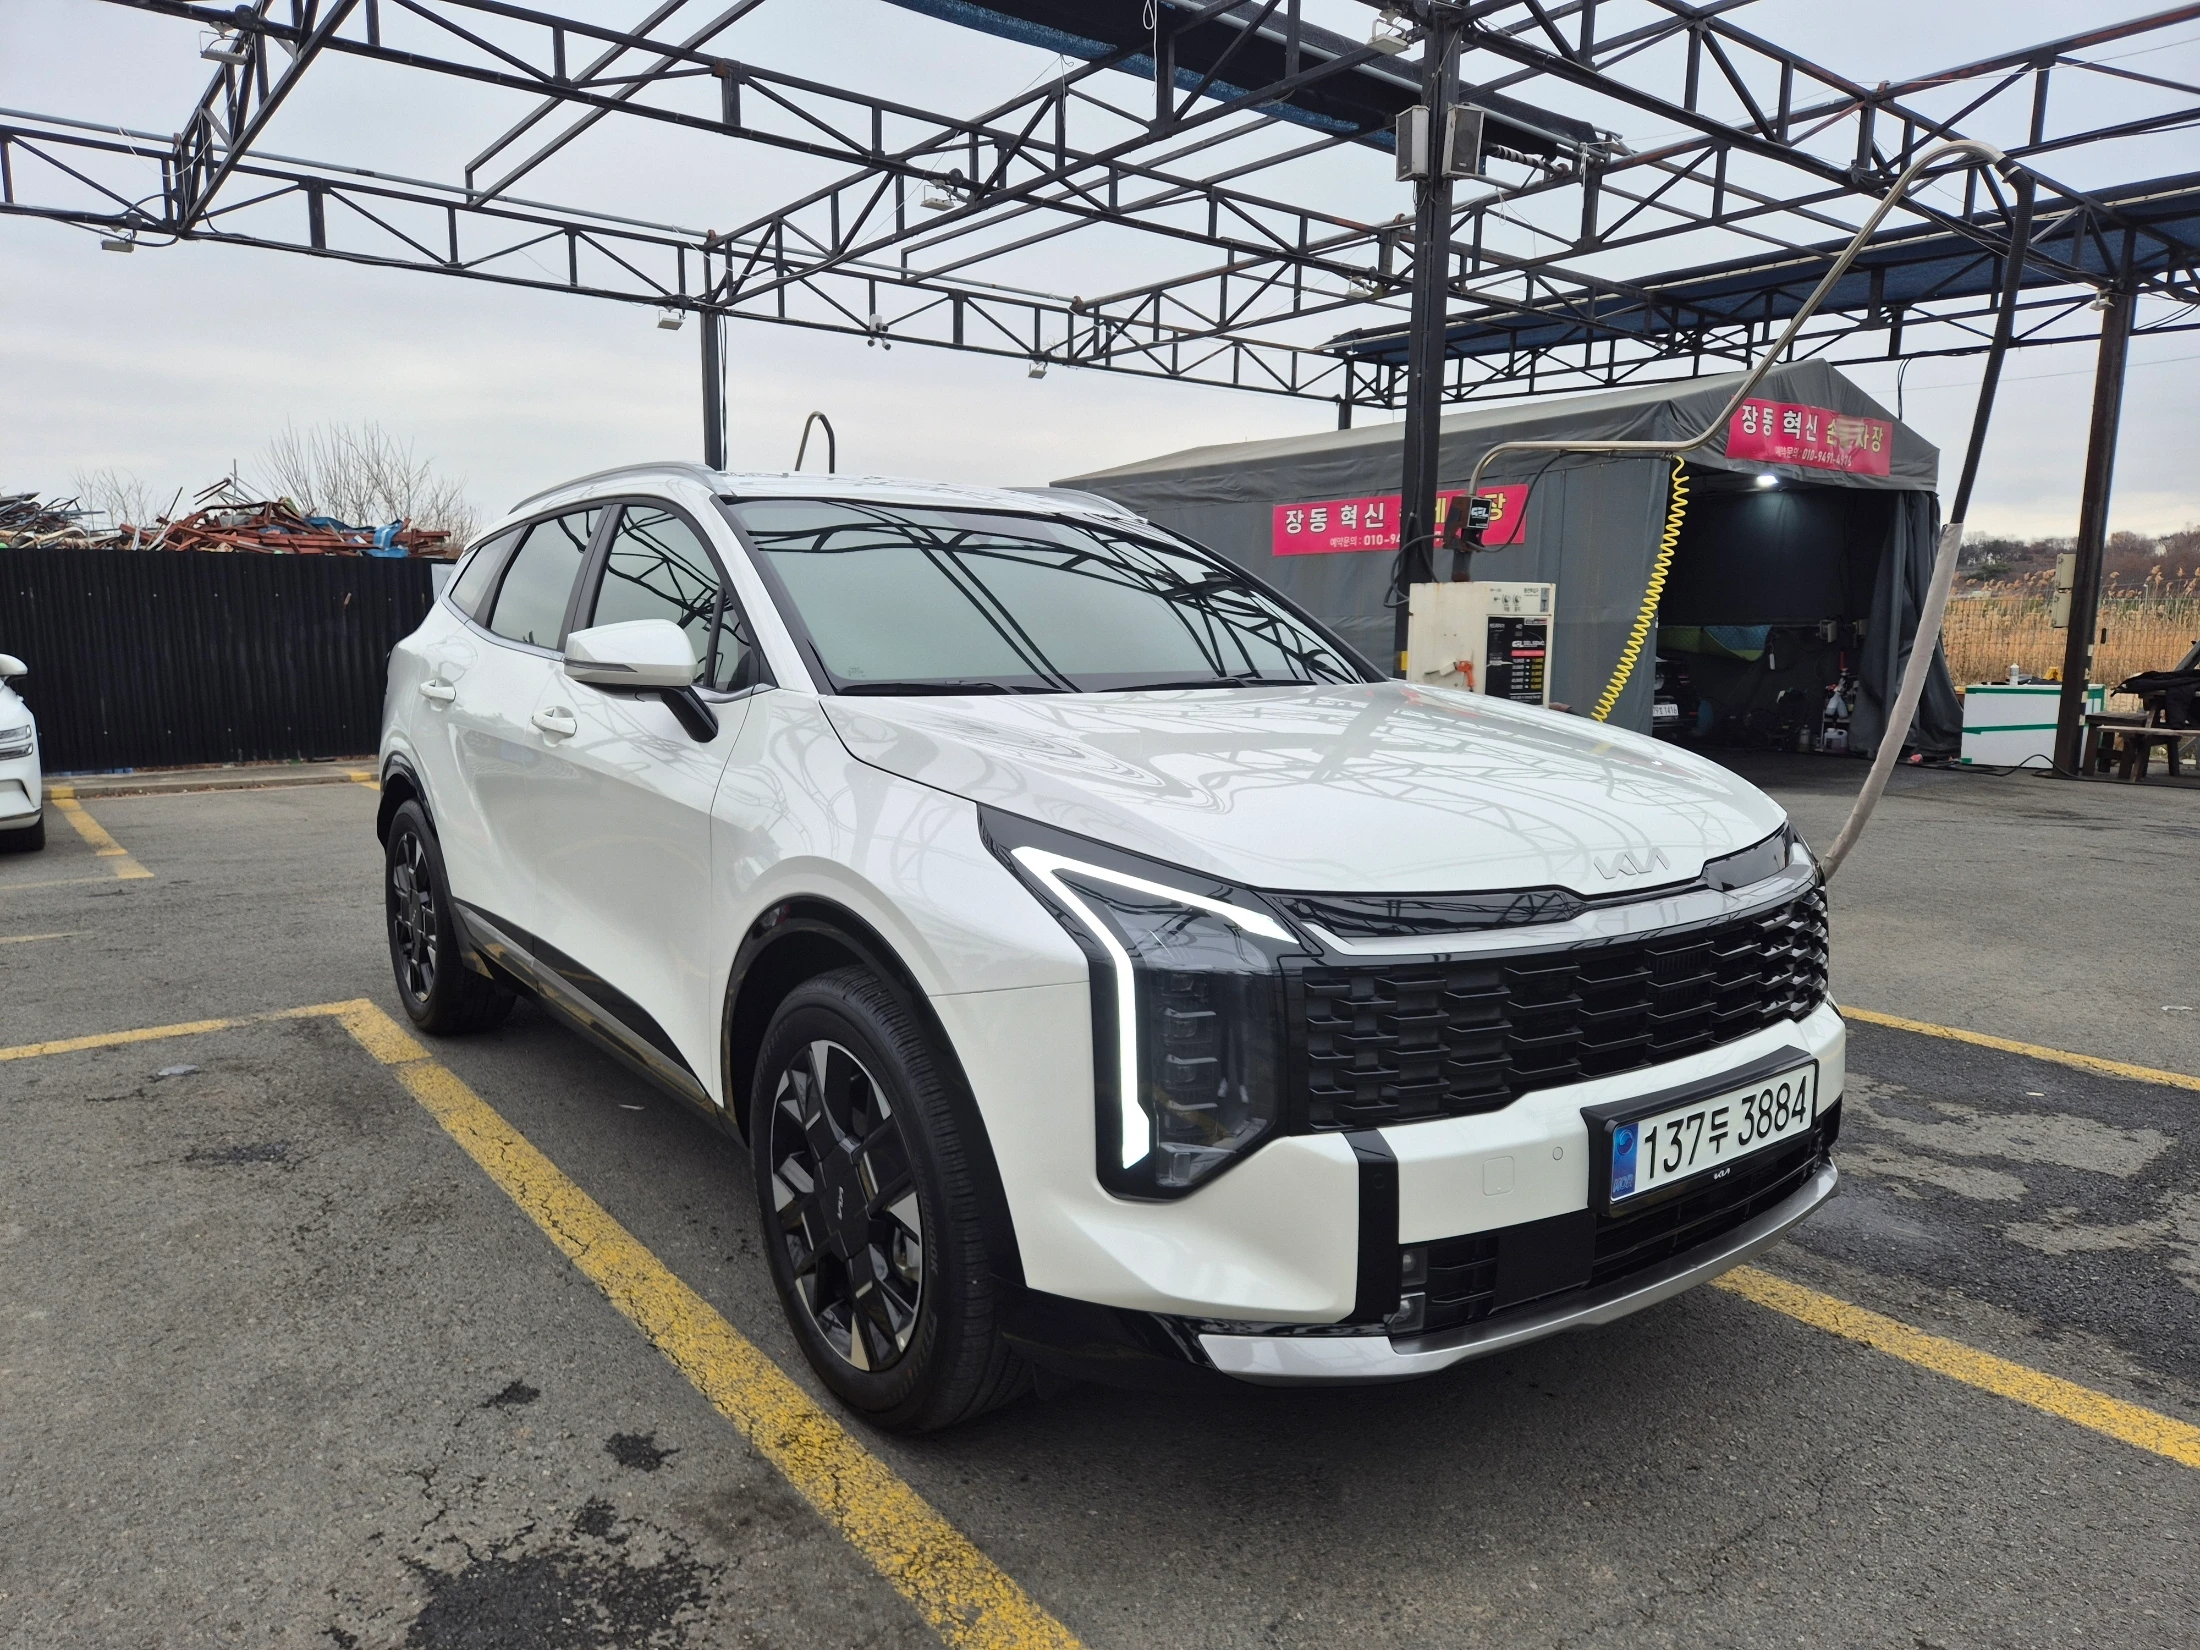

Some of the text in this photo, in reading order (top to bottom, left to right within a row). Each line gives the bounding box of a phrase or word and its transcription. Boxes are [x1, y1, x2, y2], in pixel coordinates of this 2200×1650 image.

[1742, 405, 1774, 436] 장동
[1783, 410, 1819, 442] 혁신
[1285, 507, 1328, 534] 장동
[1340, 502, 1385, 530] 혁신
[1593, 847, 1671, 880] KIA
[1643, 1074, 1808, 1180] 137두 3884
[1713, 1167, 1731, 1180] KIA
